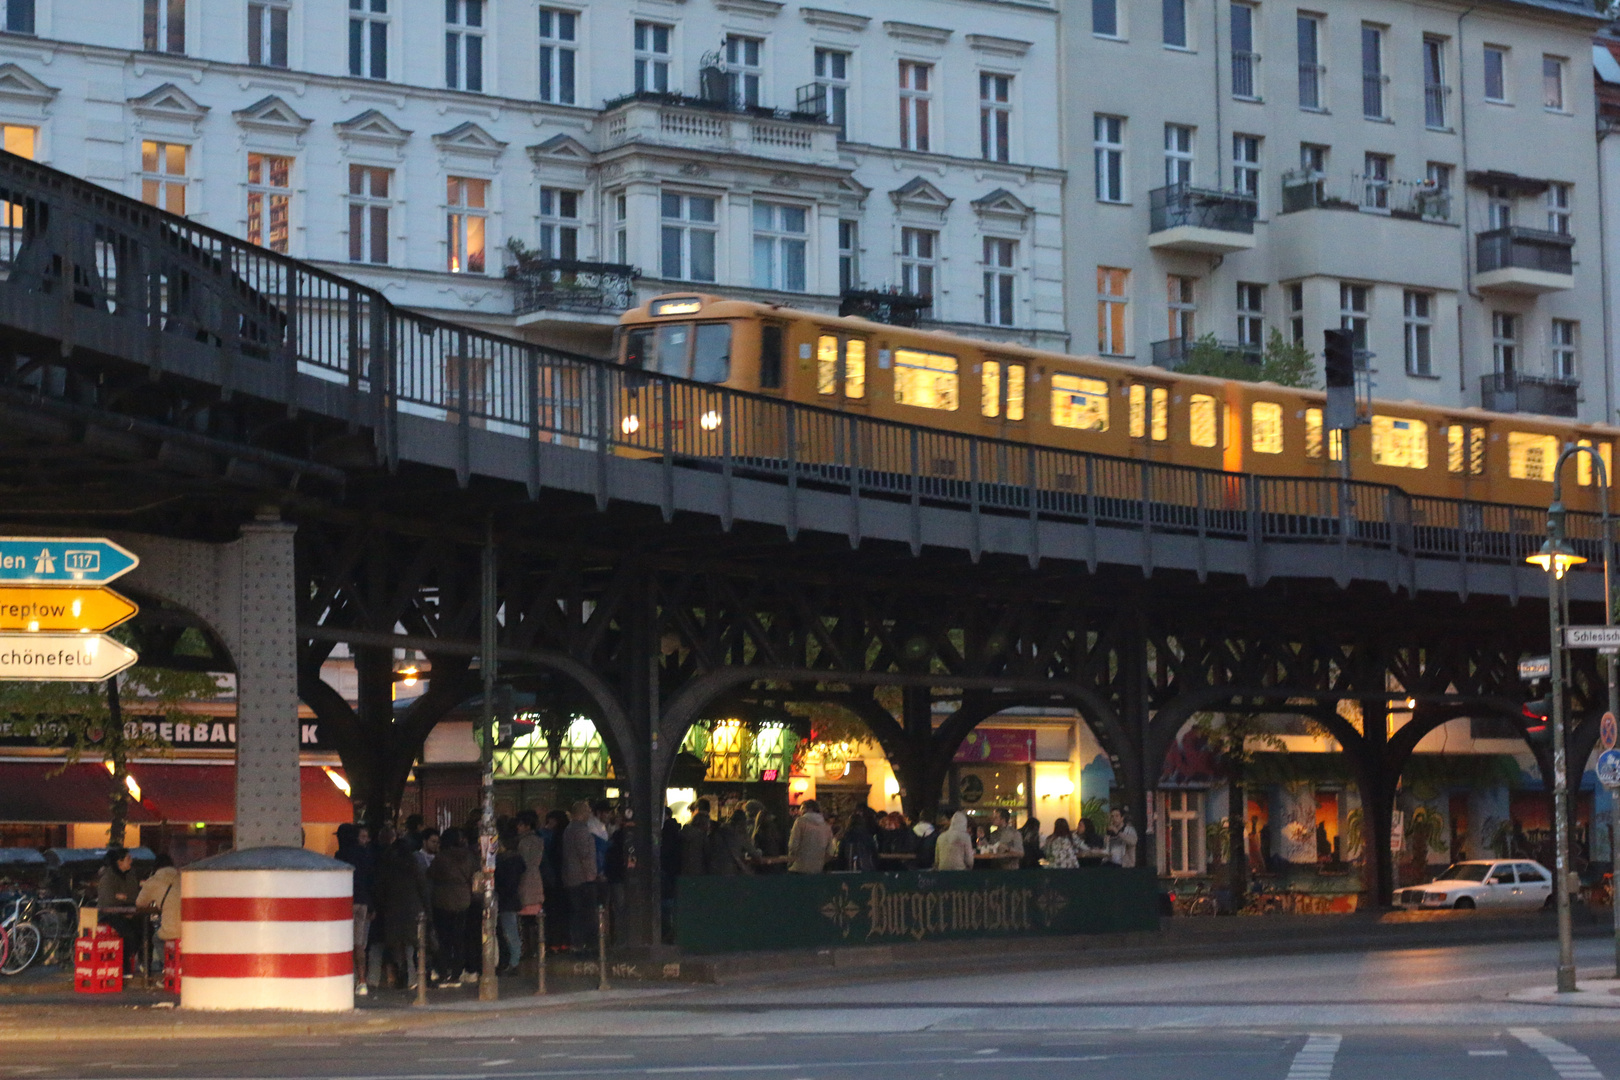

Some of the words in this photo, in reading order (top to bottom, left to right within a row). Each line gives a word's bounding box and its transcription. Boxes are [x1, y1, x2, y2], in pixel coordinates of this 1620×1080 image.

[72, 554, 93, 568] 117
[0, 602, 66, 620] reptow
[1573, 630, 1620, 642] Schlesisch
[1, 649, 93, 666] chönefeld
